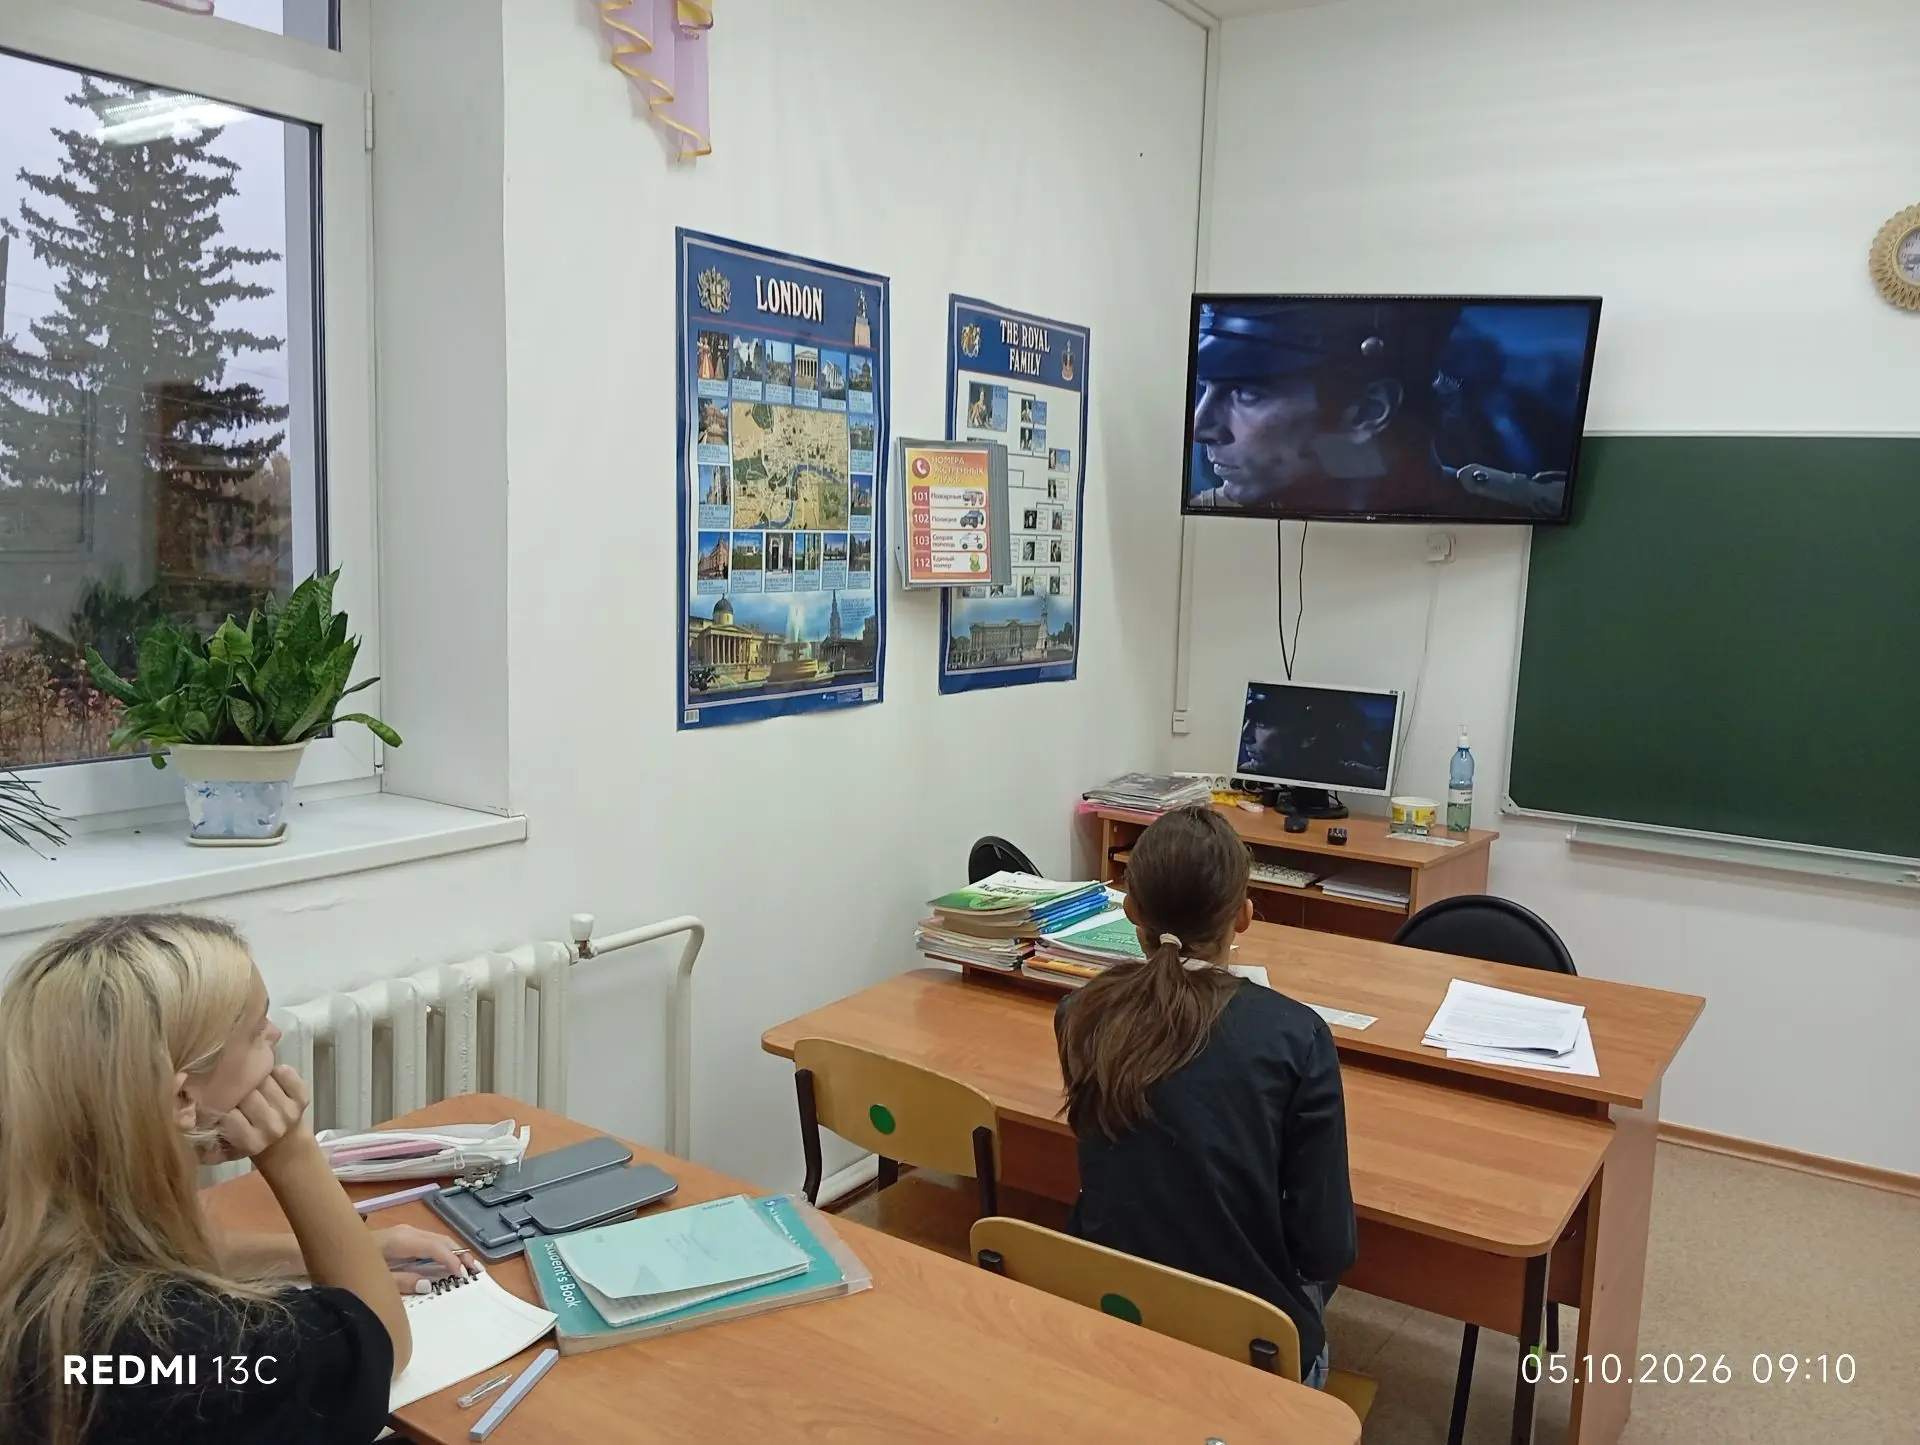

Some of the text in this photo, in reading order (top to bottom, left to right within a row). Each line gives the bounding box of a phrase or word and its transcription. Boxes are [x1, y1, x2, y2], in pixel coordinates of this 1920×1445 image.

[755, 275, 824, 322] LONDON
[1000, 319, 1051, 353] THE ROYAL
[1009, 348, 1042, 376] FAMILY
[913, 491, 929, 501] 101
[914, 512, 929, 524] 102
[914, 534, 930, 546] 103
[915, 557, 931, 568] 112
[560, 1281, 581, 1309] Book
